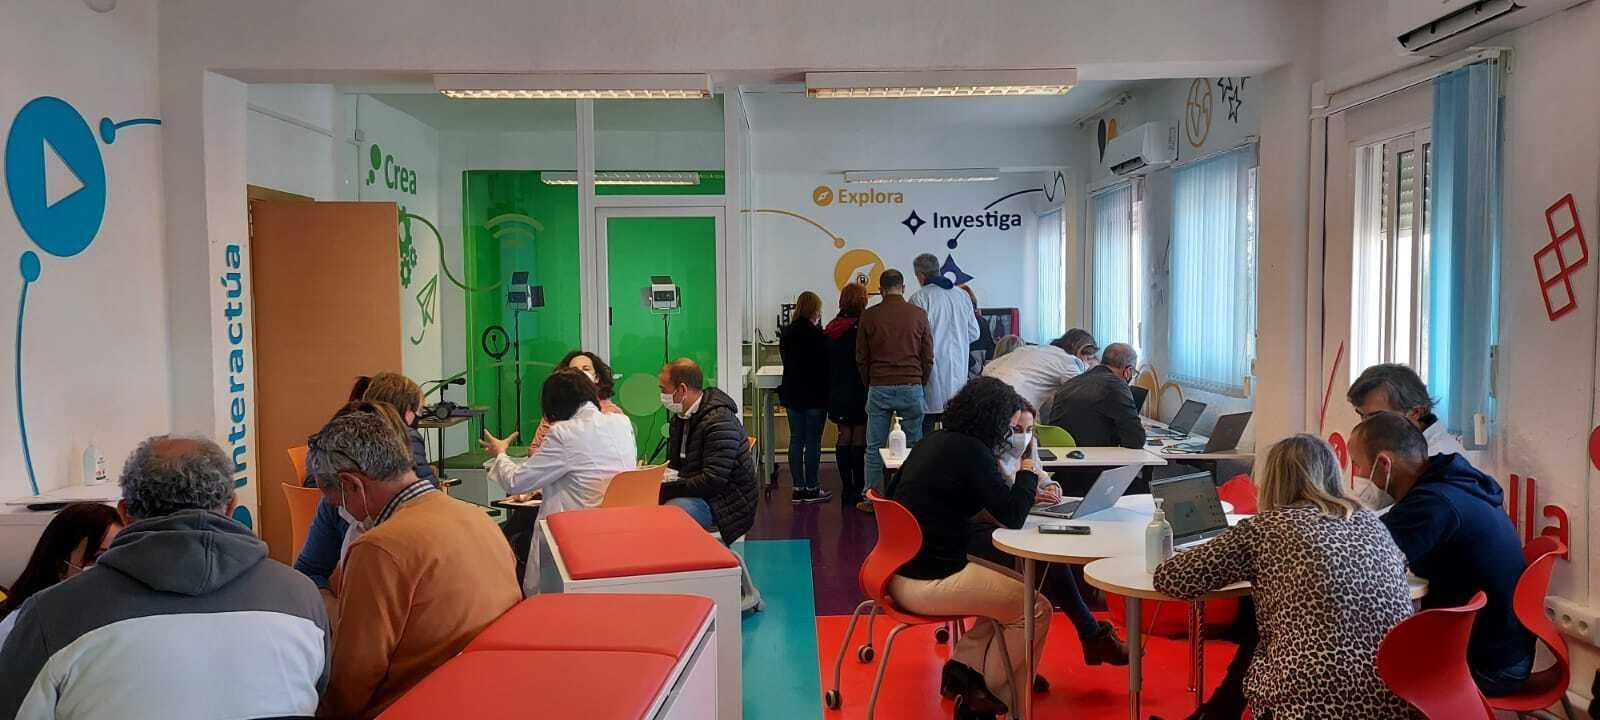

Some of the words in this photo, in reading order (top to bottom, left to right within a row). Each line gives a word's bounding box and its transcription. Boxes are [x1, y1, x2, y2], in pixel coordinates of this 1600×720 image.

[384, 154, 417, 195] Crea
[838, 188, 904, 207] Explora
[933, 210, 1022, 231] Investiga
